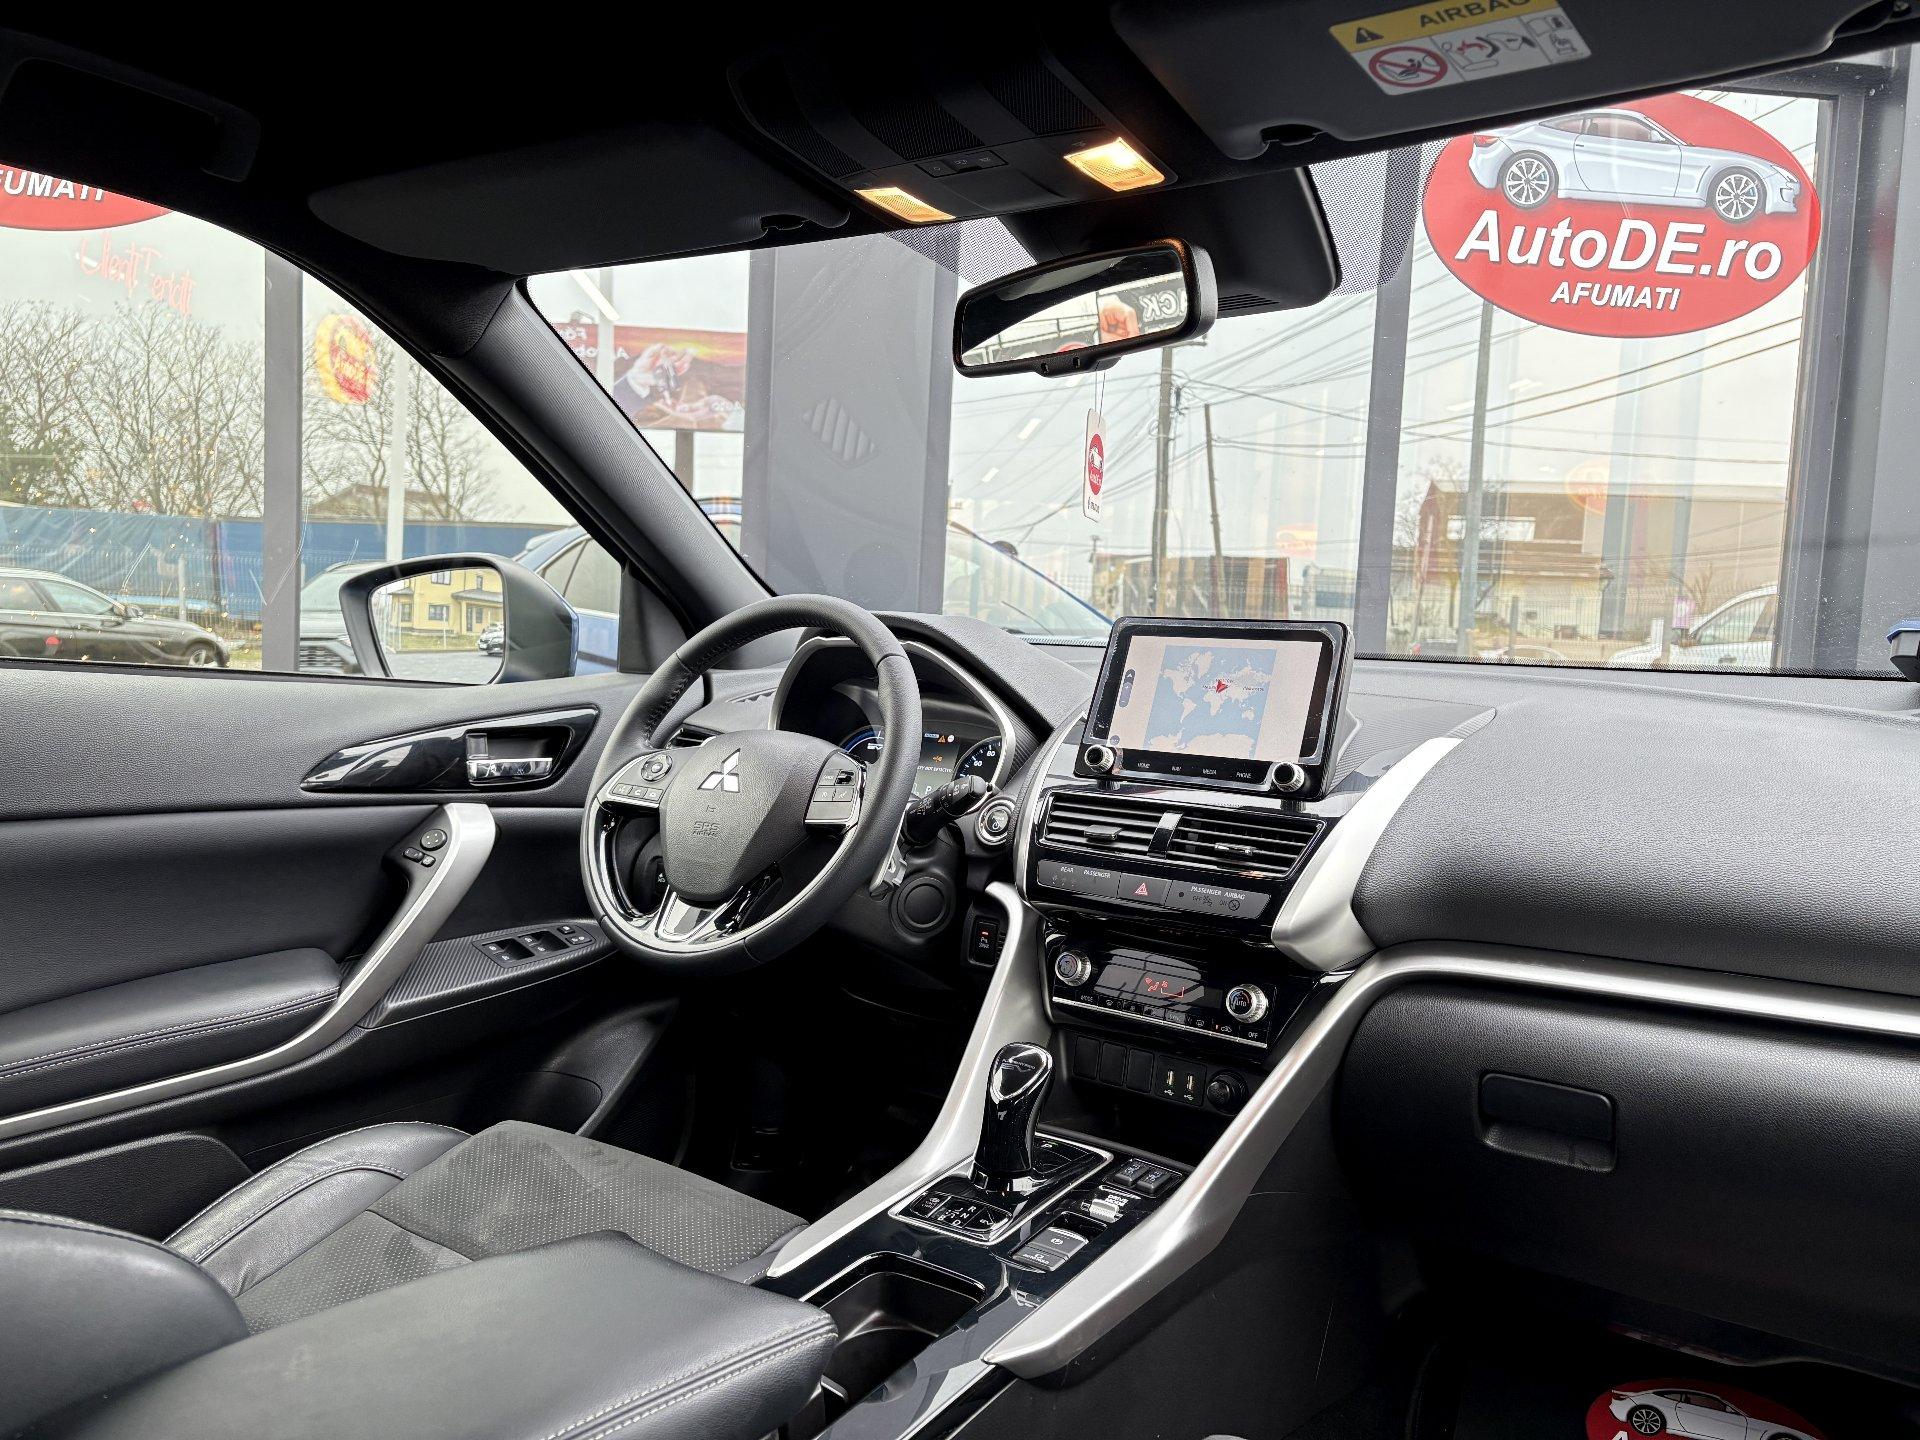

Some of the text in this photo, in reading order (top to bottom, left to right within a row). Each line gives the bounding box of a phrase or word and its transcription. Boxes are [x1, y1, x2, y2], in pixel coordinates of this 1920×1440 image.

[1455, 209, 1782, 280] AutoDE.ro
[1550, 281, 1680, 310] AFUMATI
[1083, 869, 1111, 879] PASSENGER
[1190, 885, 1246, 900] PASSENGER AIRBAG
[1248, 1031, 1259, 1039] OFF
[967, 1205, 977, 1213] R
